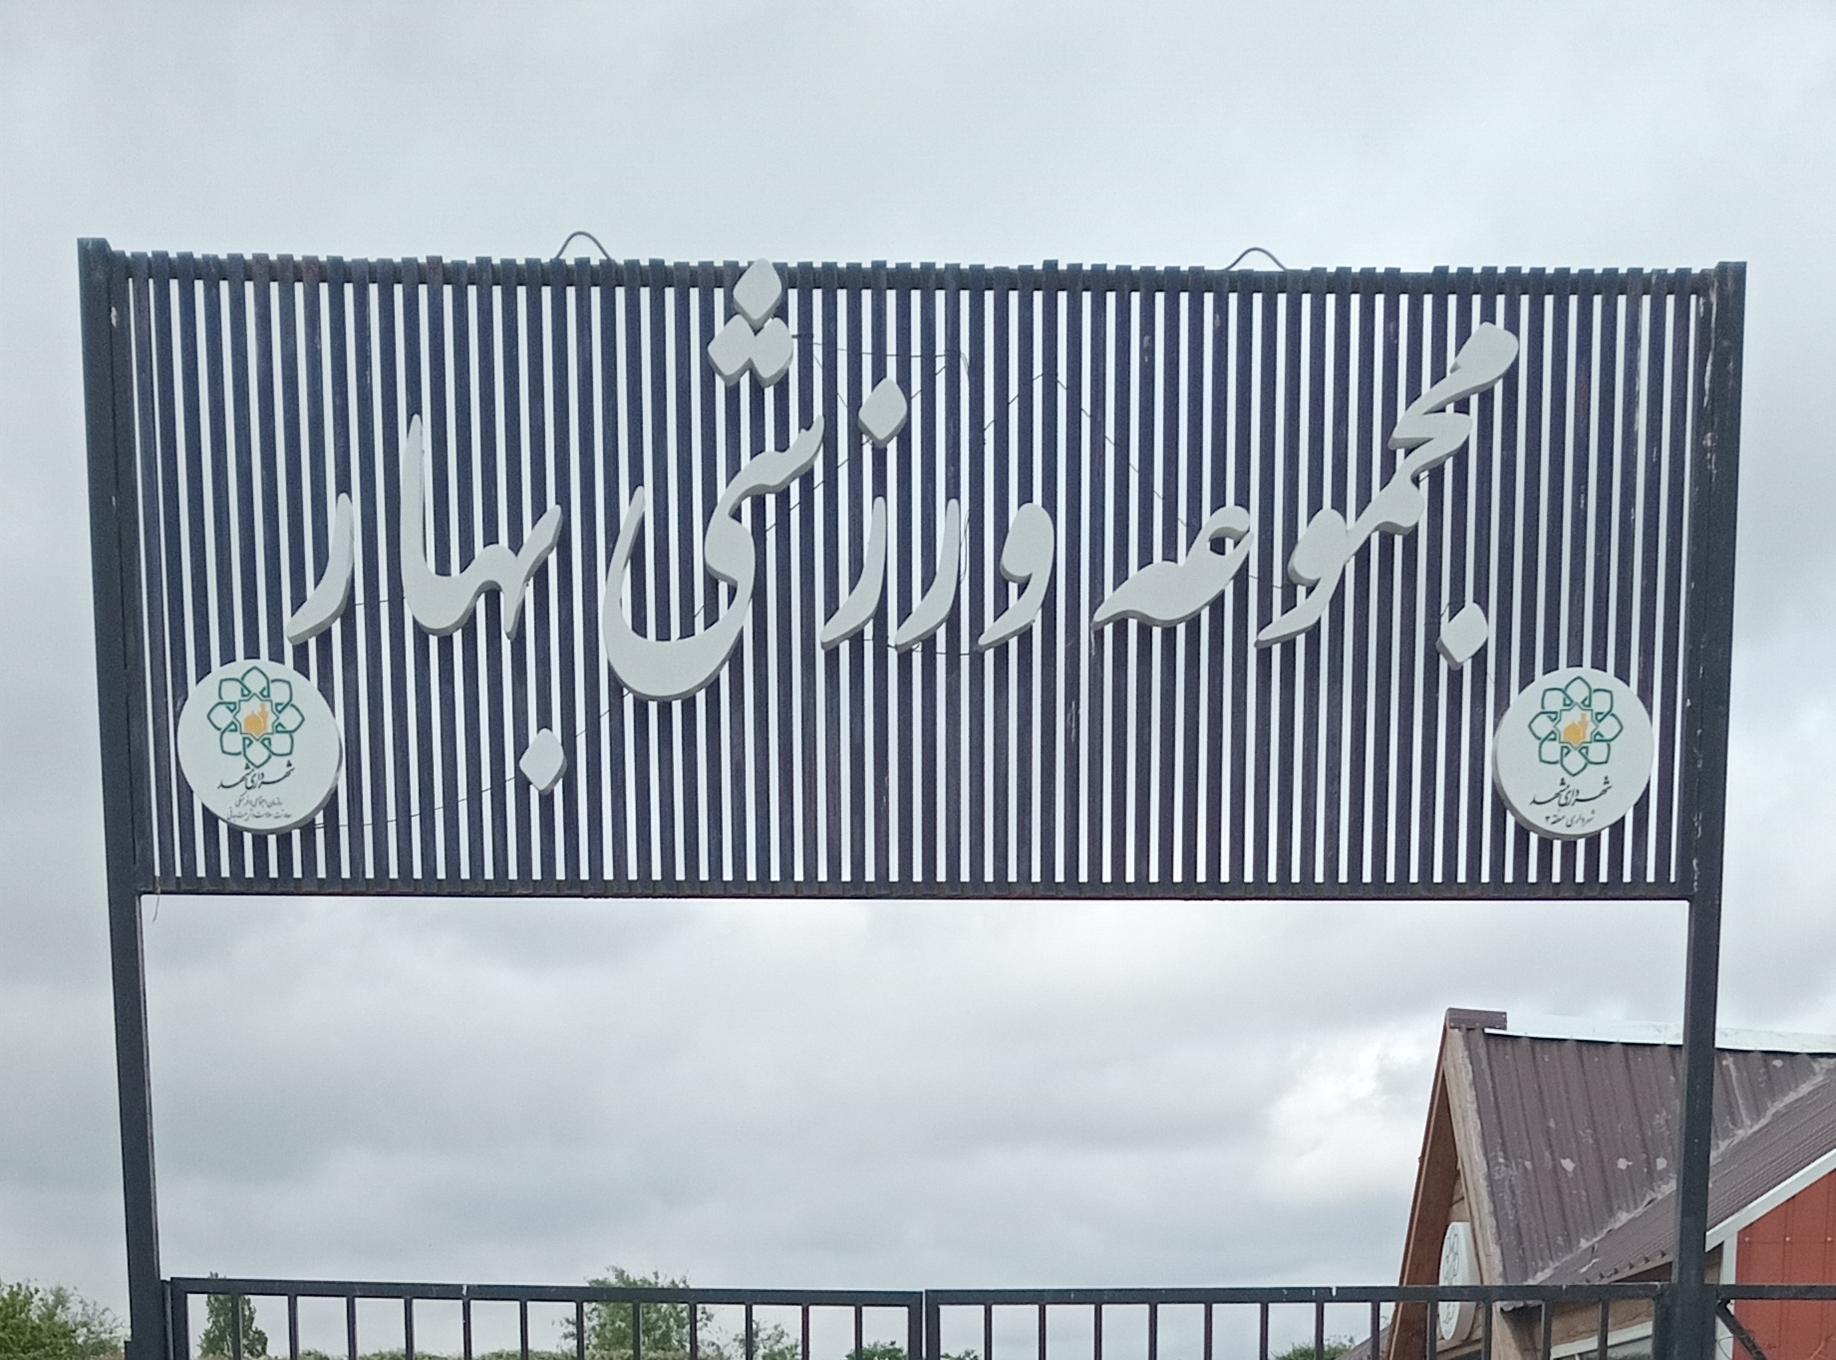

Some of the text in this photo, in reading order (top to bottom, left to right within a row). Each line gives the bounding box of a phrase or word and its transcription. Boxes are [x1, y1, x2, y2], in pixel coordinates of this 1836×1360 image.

[285, 258, 1520, 795] مجموعه ورزشی بهار
[217, 760, 295, 790] شهرداری مشهد
[1528, 775, 1612, 808] شهرداری مشهد
